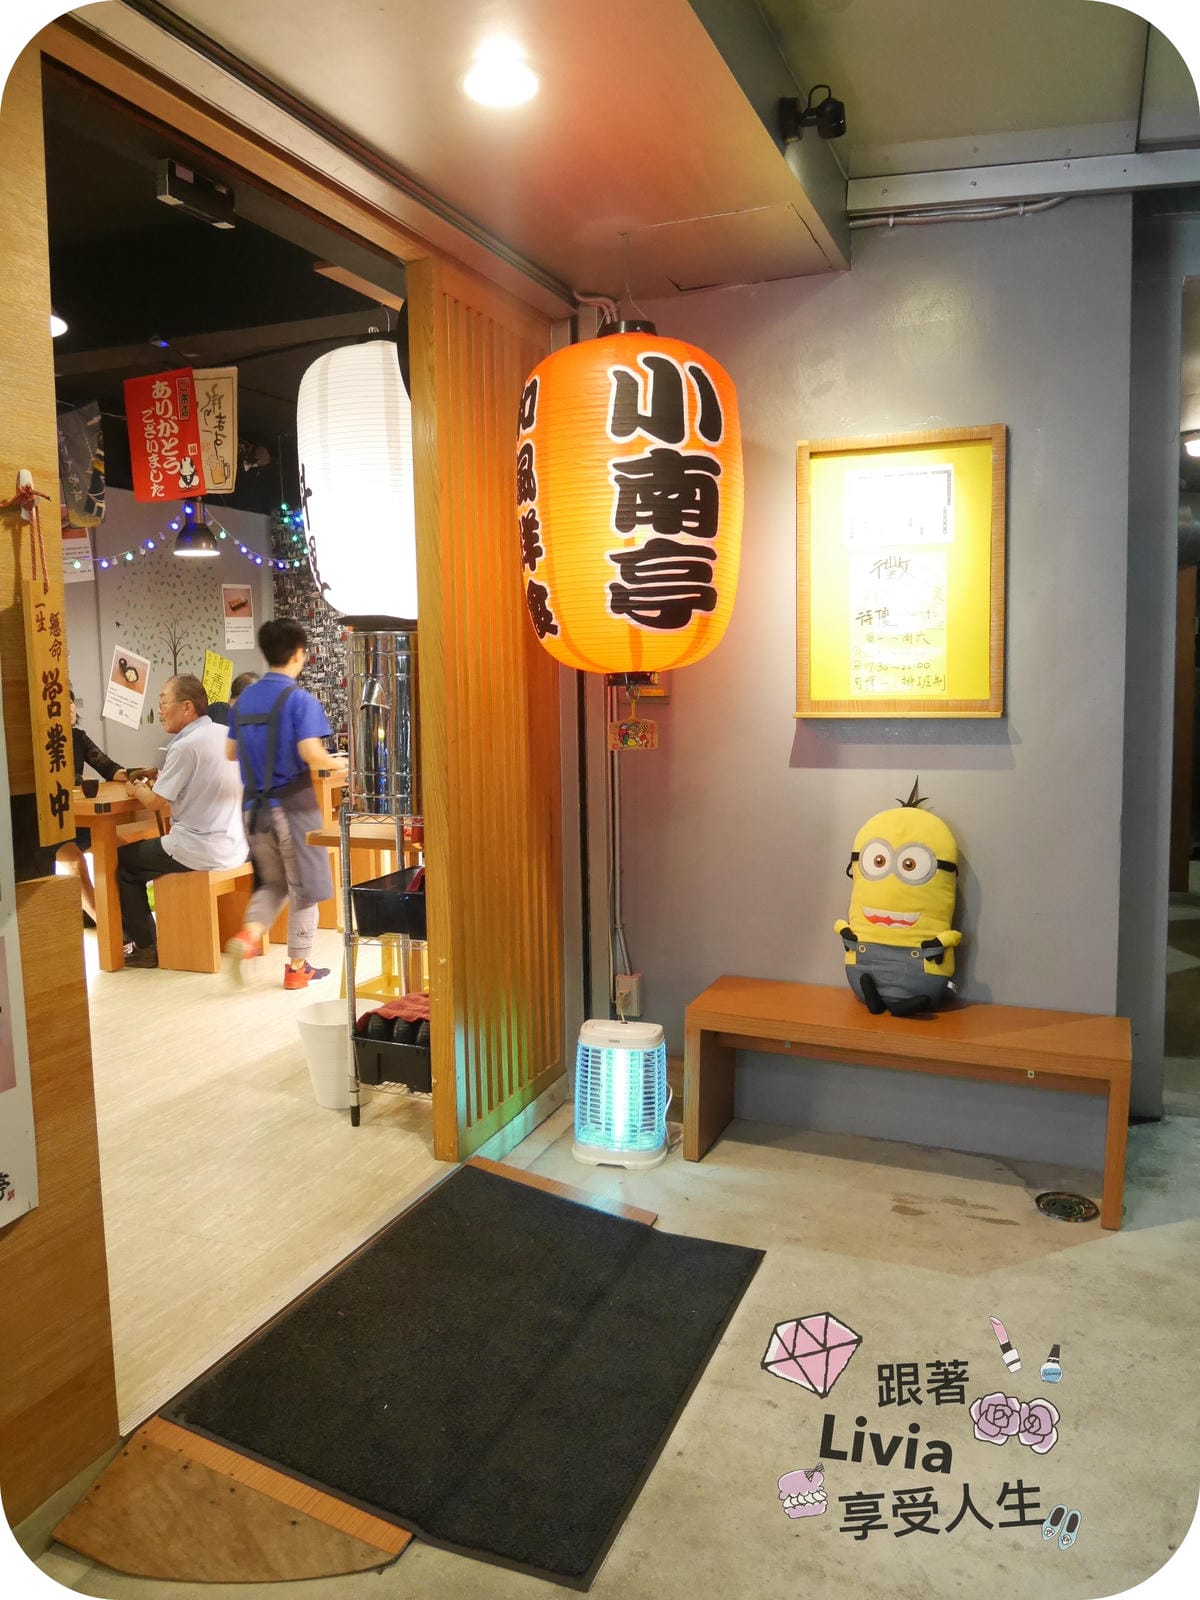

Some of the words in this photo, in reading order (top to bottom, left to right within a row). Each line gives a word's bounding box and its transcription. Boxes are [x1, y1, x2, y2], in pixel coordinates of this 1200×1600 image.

[141, 407, 166, 498] ございました
[152, 380, 181, 475] ありがとう
[608, 353, 723, 631] 小南亭
